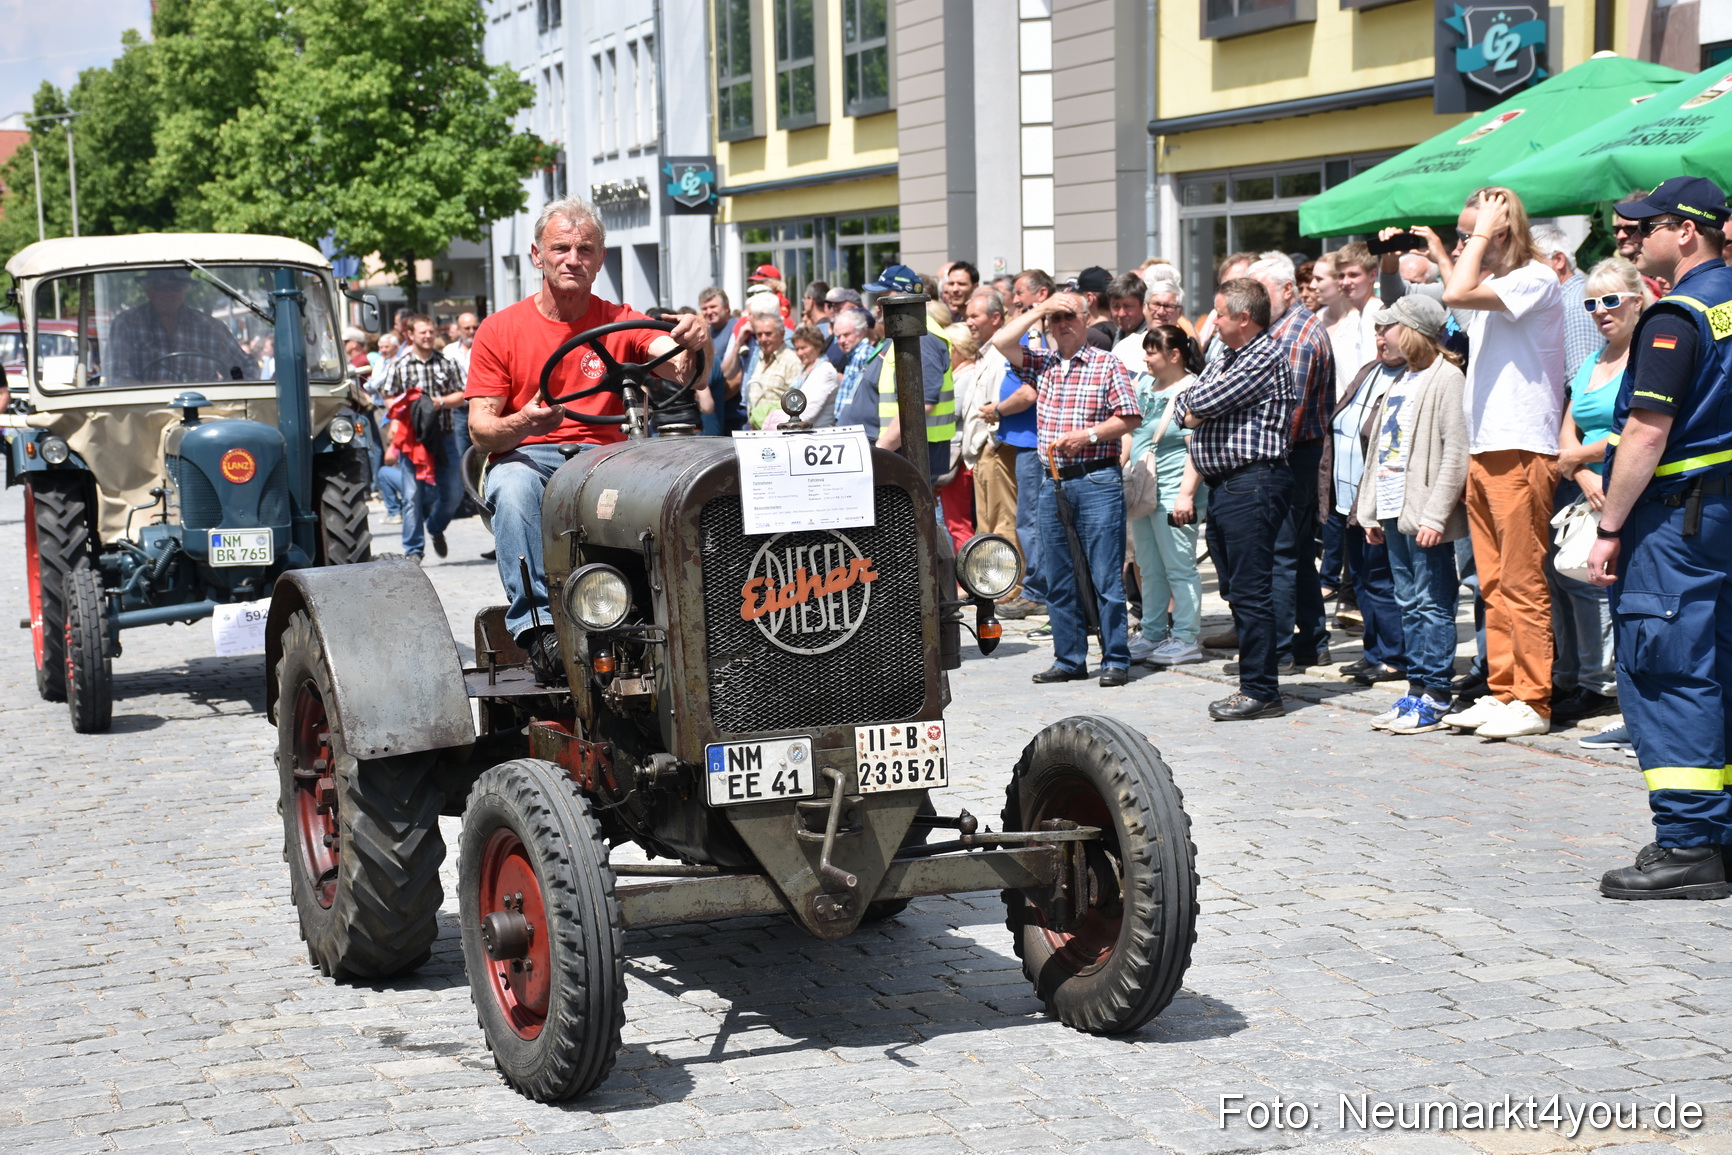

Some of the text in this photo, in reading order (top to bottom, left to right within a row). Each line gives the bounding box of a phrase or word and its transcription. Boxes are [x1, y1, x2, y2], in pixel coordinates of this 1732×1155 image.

[1482, 23, 1521, 72] G2
[681, 171, 700, 197] G2
[227, 461, 249, 470] LANZ
[804, 444, 846, 467] 627
[217, 547, 267, 561] BR 765
[222, 534, 241, 548] NM
[740, 558, 878, 622] Eicher
[245, 608, 268, 622] 592
[728, 745, 762, 772] NM
[859, 757, 946, 786] 233521
[728, 769, 803, 799] EE 41
